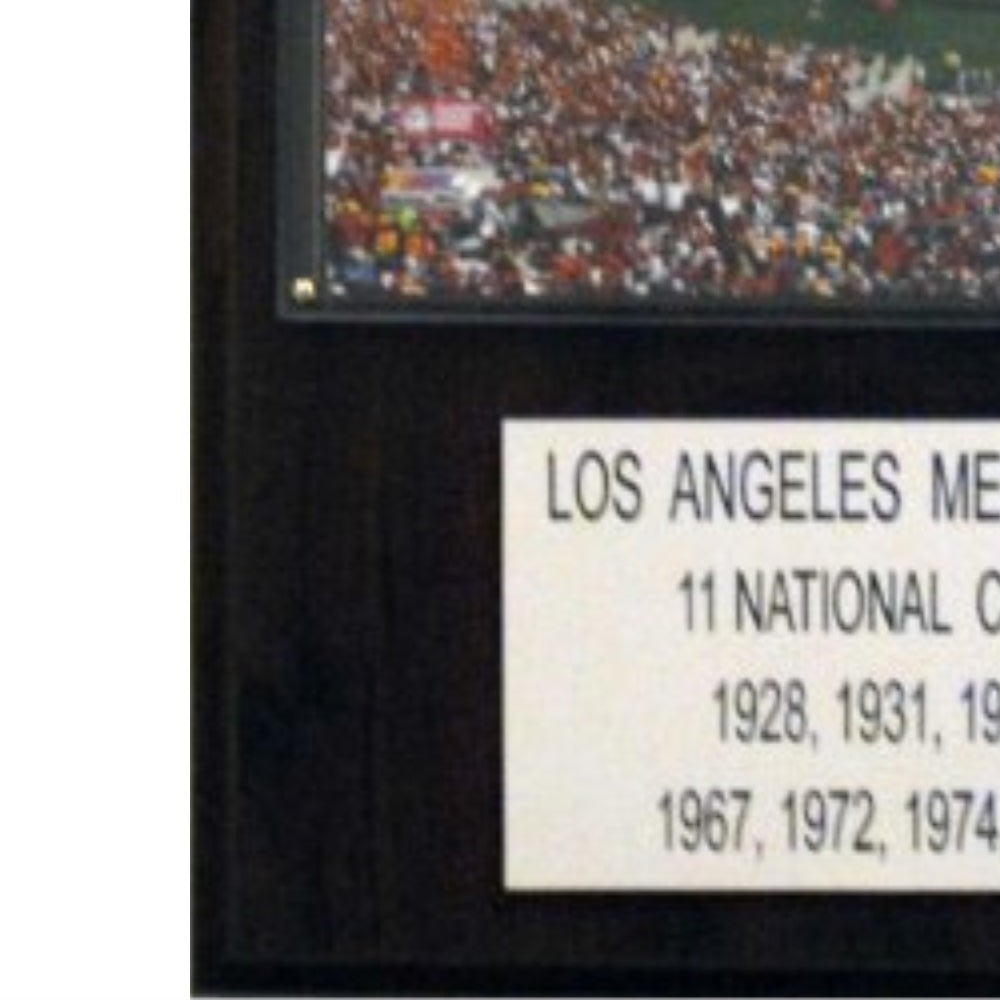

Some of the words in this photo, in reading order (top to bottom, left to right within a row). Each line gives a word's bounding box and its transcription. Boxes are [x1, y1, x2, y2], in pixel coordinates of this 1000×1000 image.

[546, 450, 642, 522] LOS
[669, 450, 902, 523] ANGELES
[679, 573, 716, 631] 11
[735, 569, 953, 634] NATIONAL
[713, 680, 817, 749] 1928,
[837, 680, 942, 749] 1931,
[658, 789, 763, 857] 1967,
[782, 789, 887, 857] 1972,
